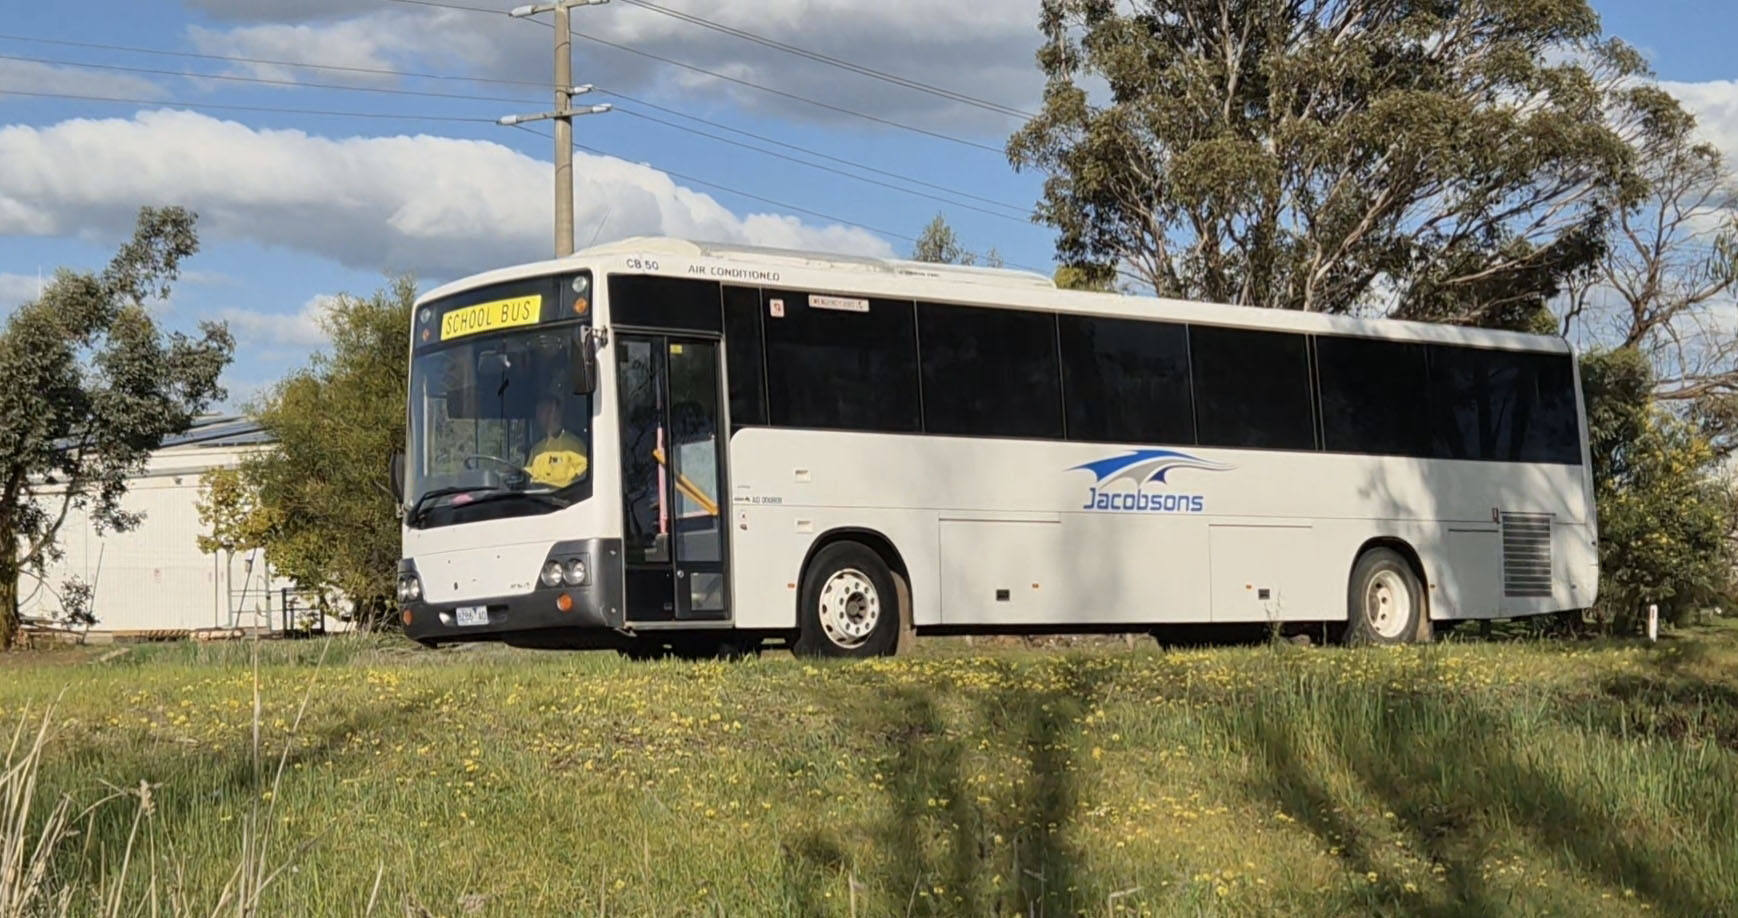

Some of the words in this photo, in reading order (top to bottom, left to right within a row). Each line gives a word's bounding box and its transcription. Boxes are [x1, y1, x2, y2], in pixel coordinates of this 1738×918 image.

[626, 258, 642, 269] CB
[644, 260, 659, 271] 50
[688, 264, 706, 275] AIR
[710, 267, 780, 281] CONDITIONED
[446, 307, 492, 335] SCHOOL
[501, 301, 531, 323] BUS
[1083, 487, 1204, 512] Jacobsons
